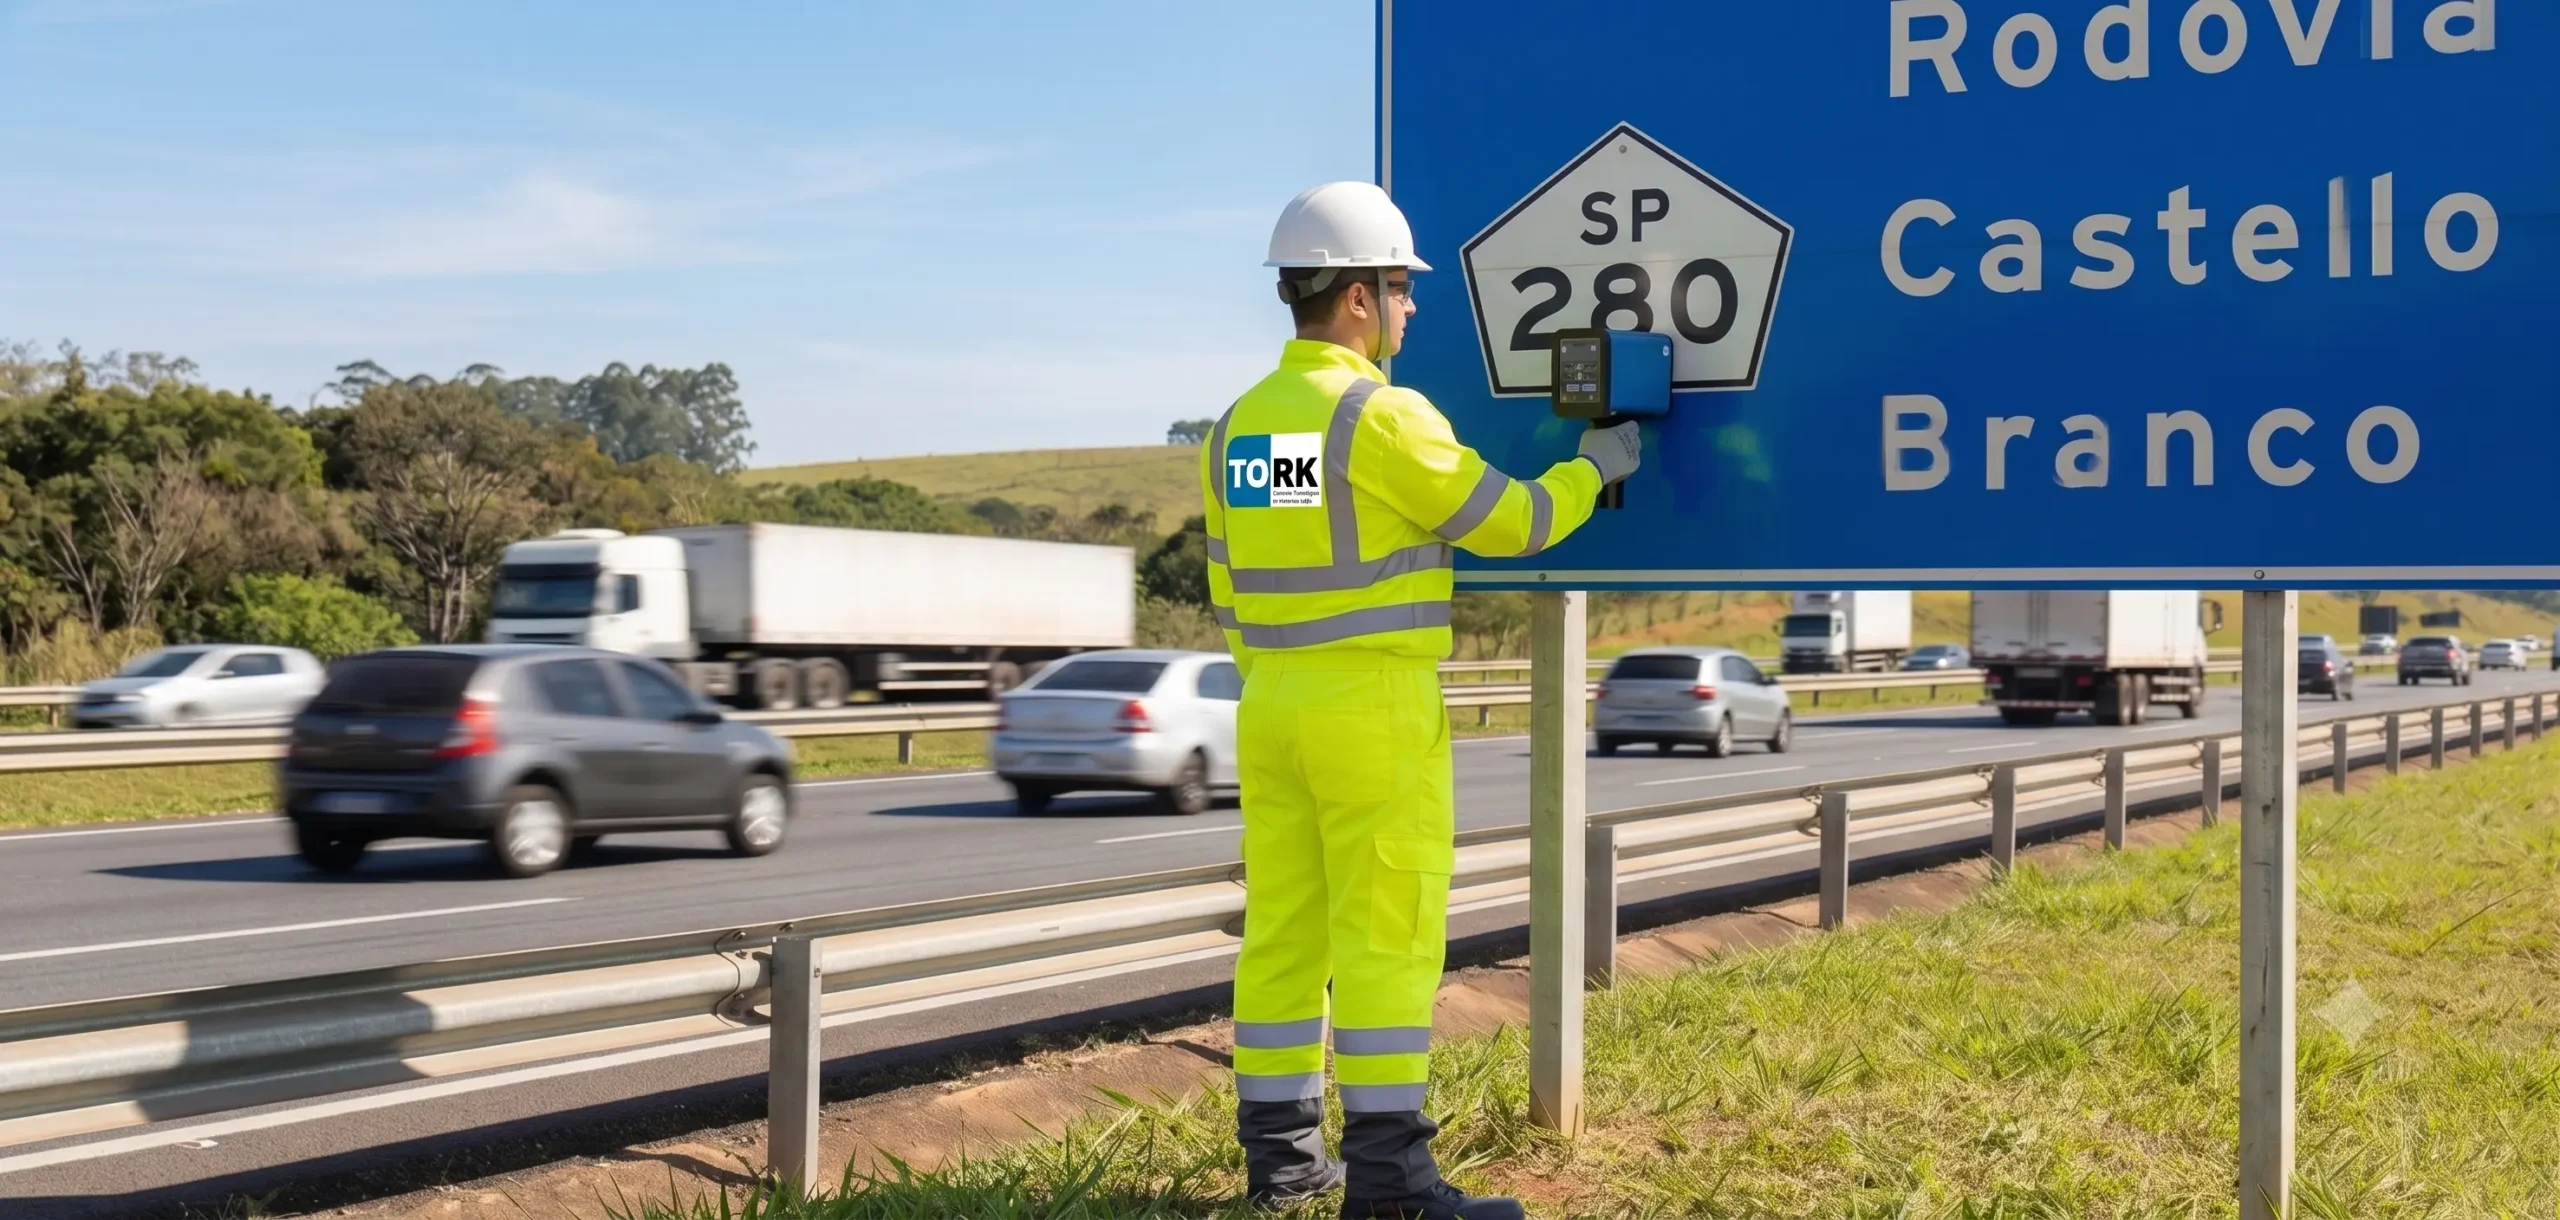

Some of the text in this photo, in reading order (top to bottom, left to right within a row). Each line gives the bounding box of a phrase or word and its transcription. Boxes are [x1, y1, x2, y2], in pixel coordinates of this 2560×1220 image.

[1889, 0, 2496, 98] Rodovia
[1579, 188, 1670, 246] SP
[1880, 171, 2499, 297] Castello
[1509, 257, 1739, 352] 280
[1228, 457, 1318, 488] TORK
[1881, 394, 2420, 491] Branco
